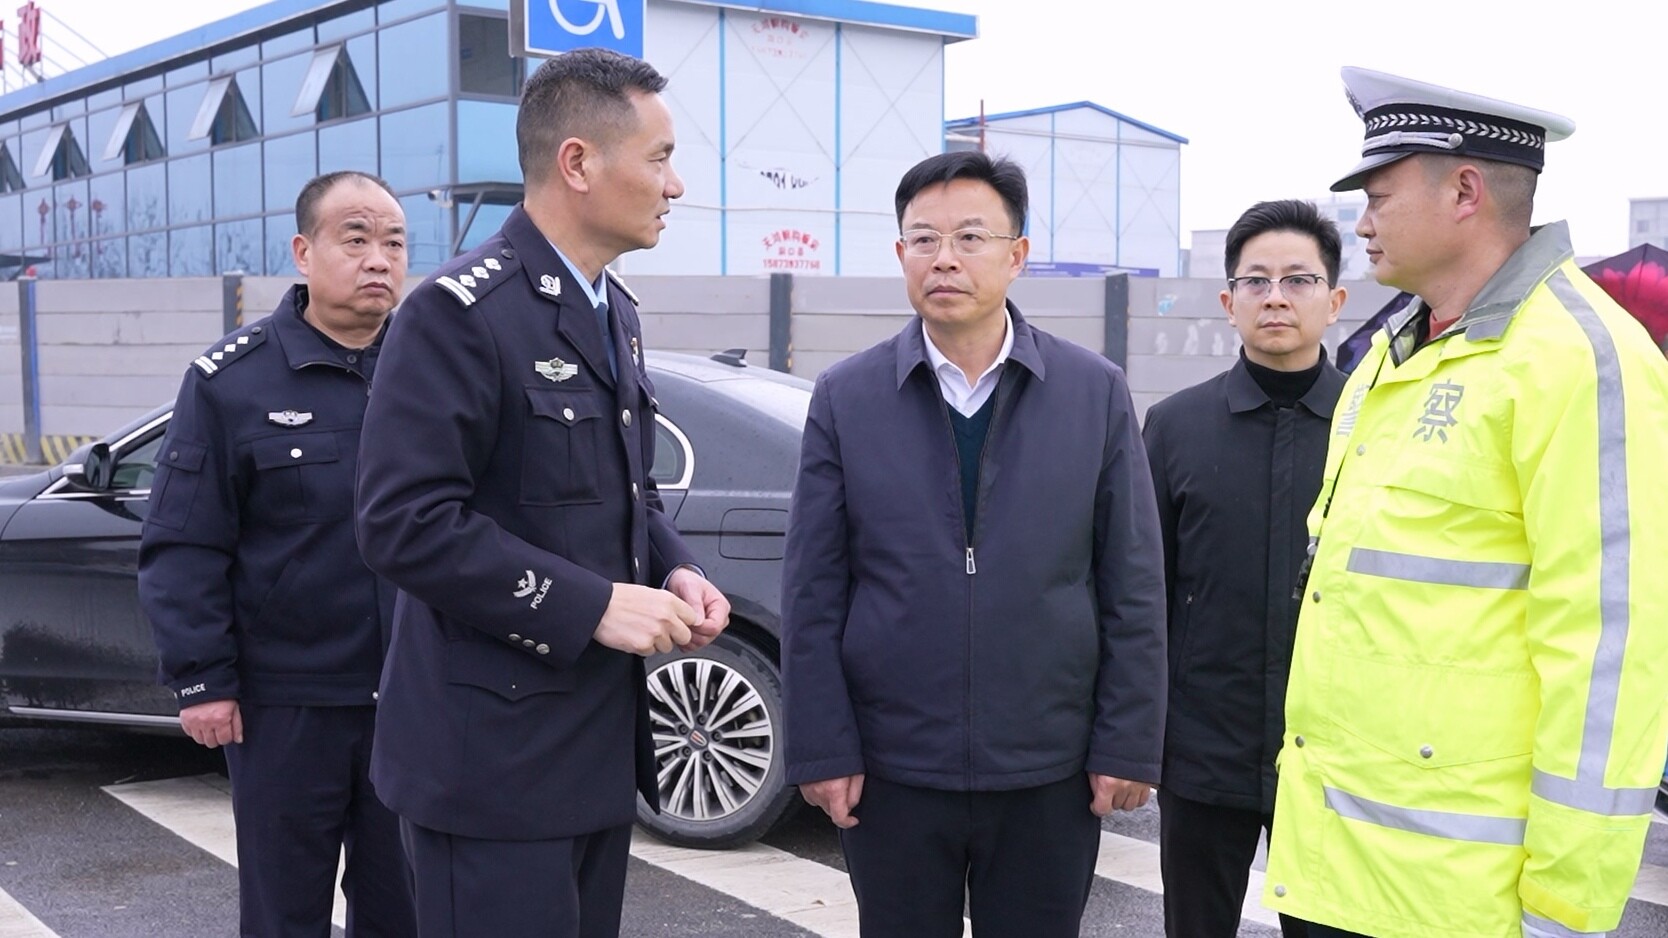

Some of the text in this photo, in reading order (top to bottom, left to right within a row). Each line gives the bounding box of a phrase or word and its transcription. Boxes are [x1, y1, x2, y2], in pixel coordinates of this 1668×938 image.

[1412, 377, 1465, 444] 察
[530, 576, 553, 610] POLICE
[180, 683, 206, 698] POLICE
